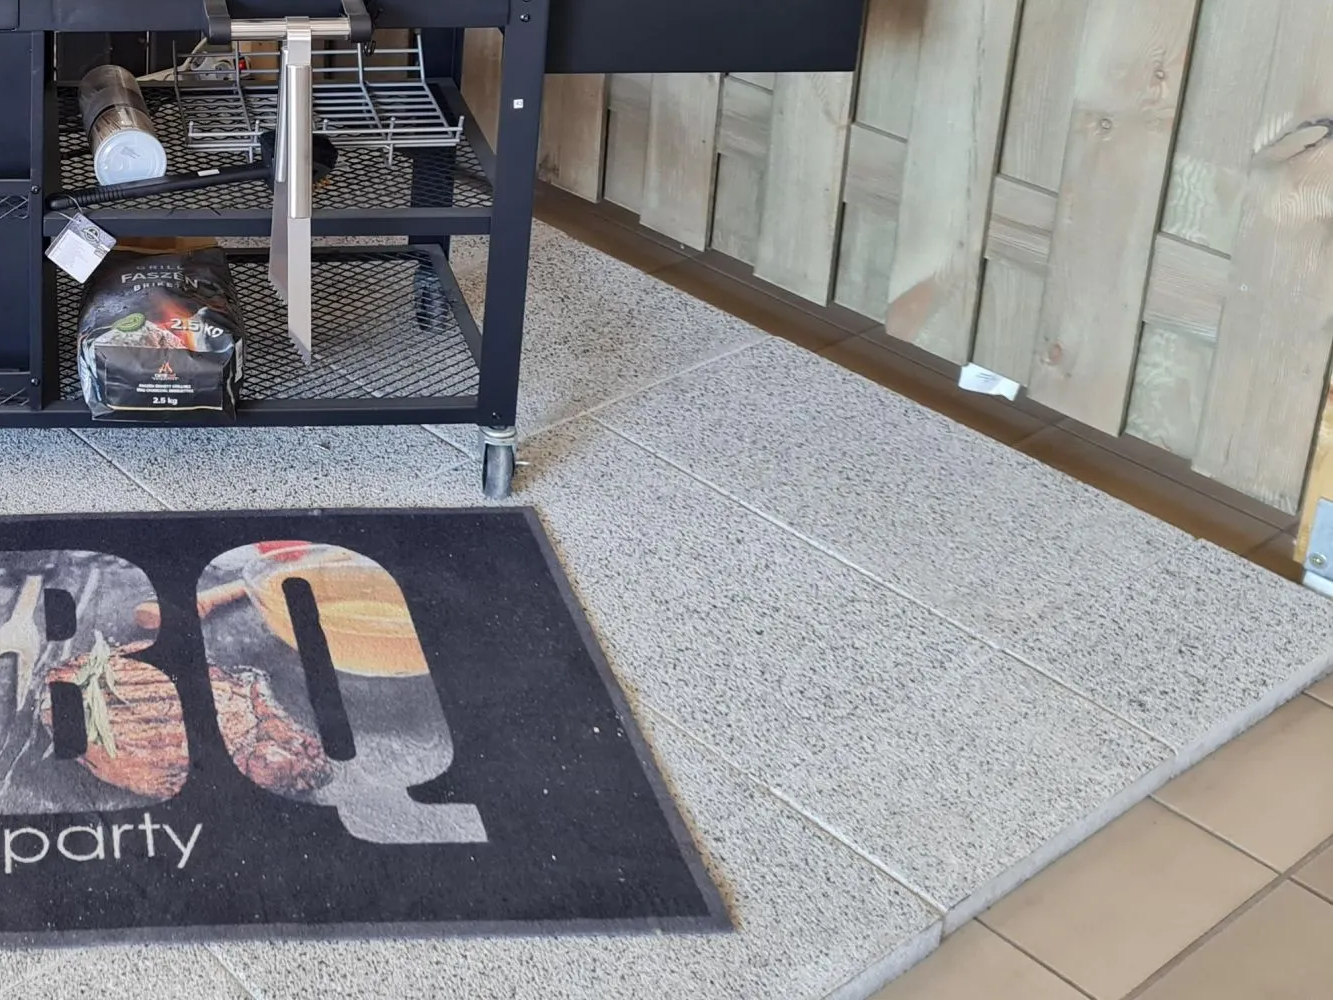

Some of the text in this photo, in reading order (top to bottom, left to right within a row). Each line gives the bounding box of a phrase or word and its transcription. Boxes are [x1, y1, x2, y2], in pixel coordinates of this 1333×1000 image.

[121, 271, 198, 289] FASZÉN
[170, 318, 201, 331] 2.5
[152, 396, 178, 405] 2.5 kg
[3, 812, 205, 874] party
